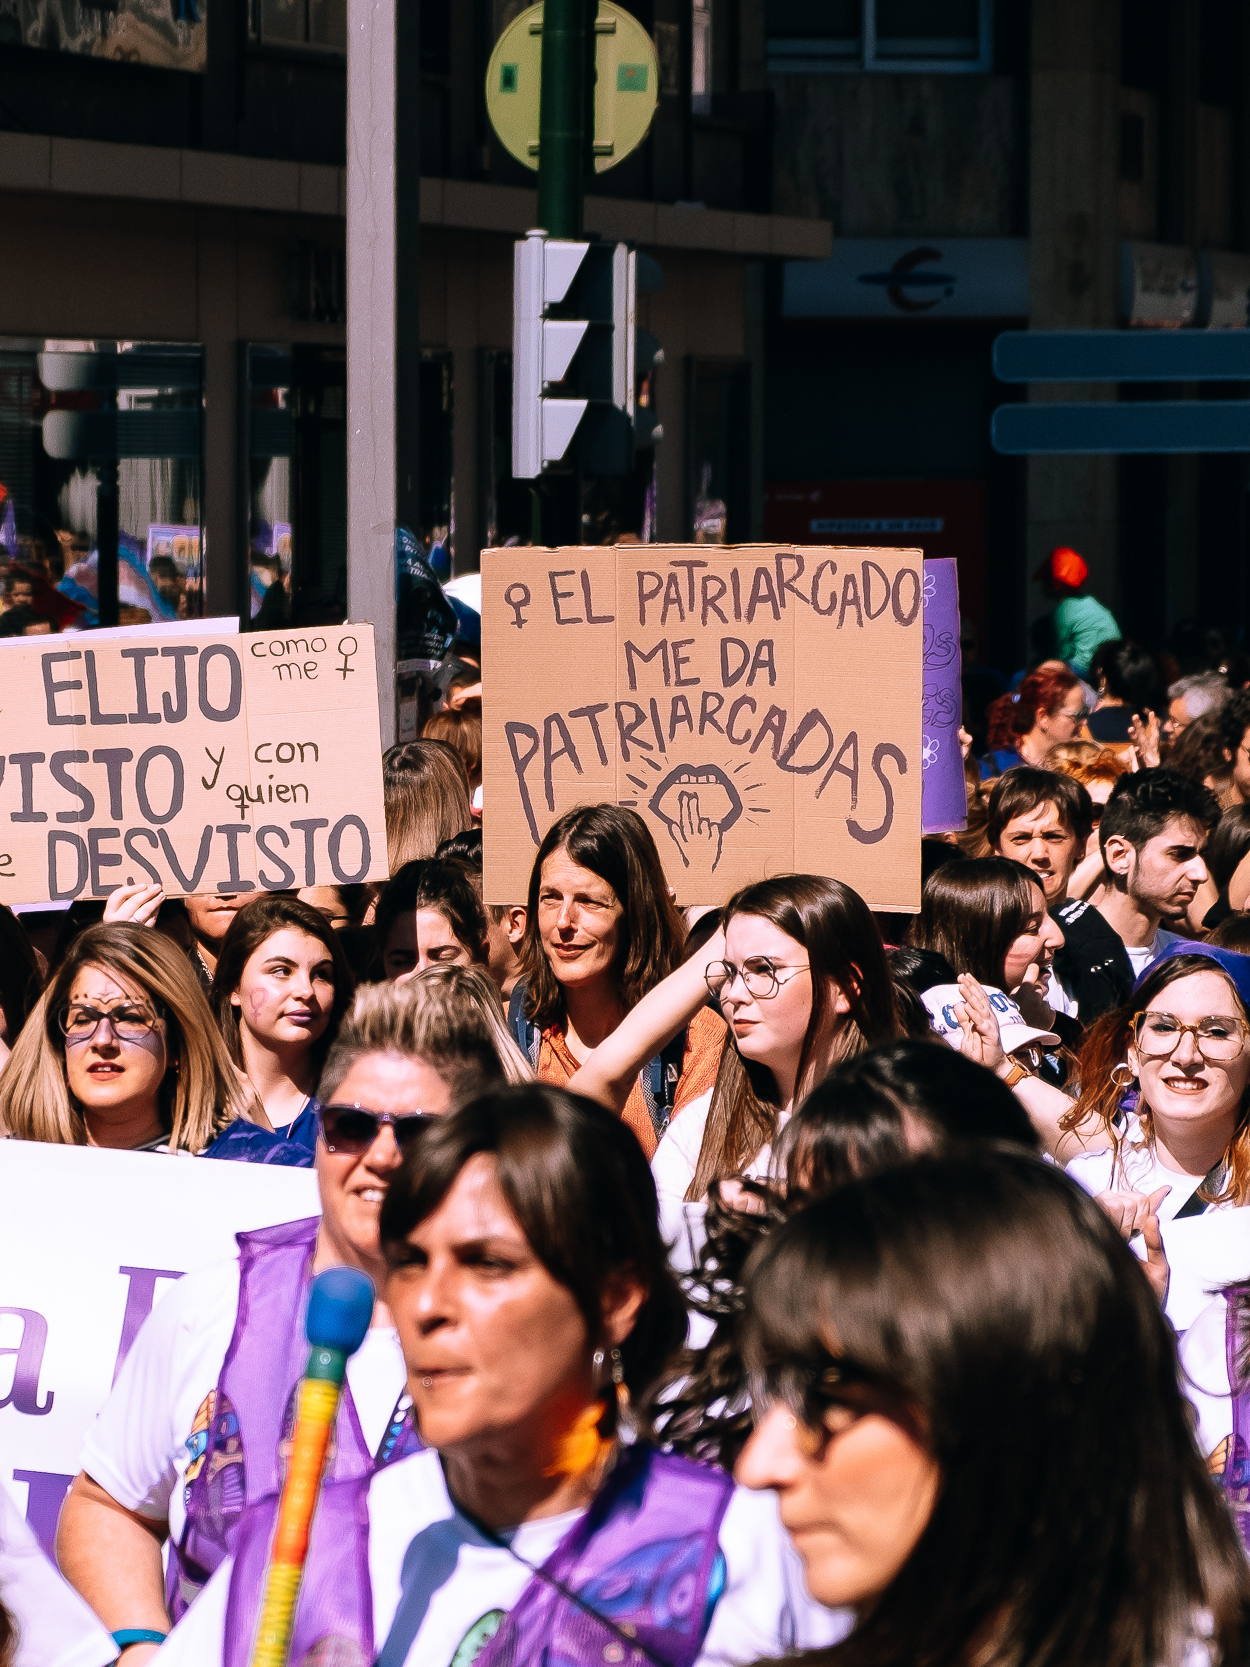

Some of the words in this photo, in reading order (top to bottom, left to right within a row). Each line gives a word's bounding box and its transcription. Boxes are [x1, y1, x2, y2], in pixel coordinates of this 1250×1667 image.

[548, 569, 616, 626] EL
[636, 553, 923, 630] PATRIARCADO
[250, 636, 327, 658] como
[273, 660, 319, 681] me
[624, 638, 702, 691] ME
[720, 637, 777, 689] DA
[41, 643, 243, 727] ELIJO
[254, 741, 319, 763] con
[505, 691, 908, 846] PATRIARCADAS
[226, 774, 310, 820] quien
[48, 814, 371, 902] DESVISTO
